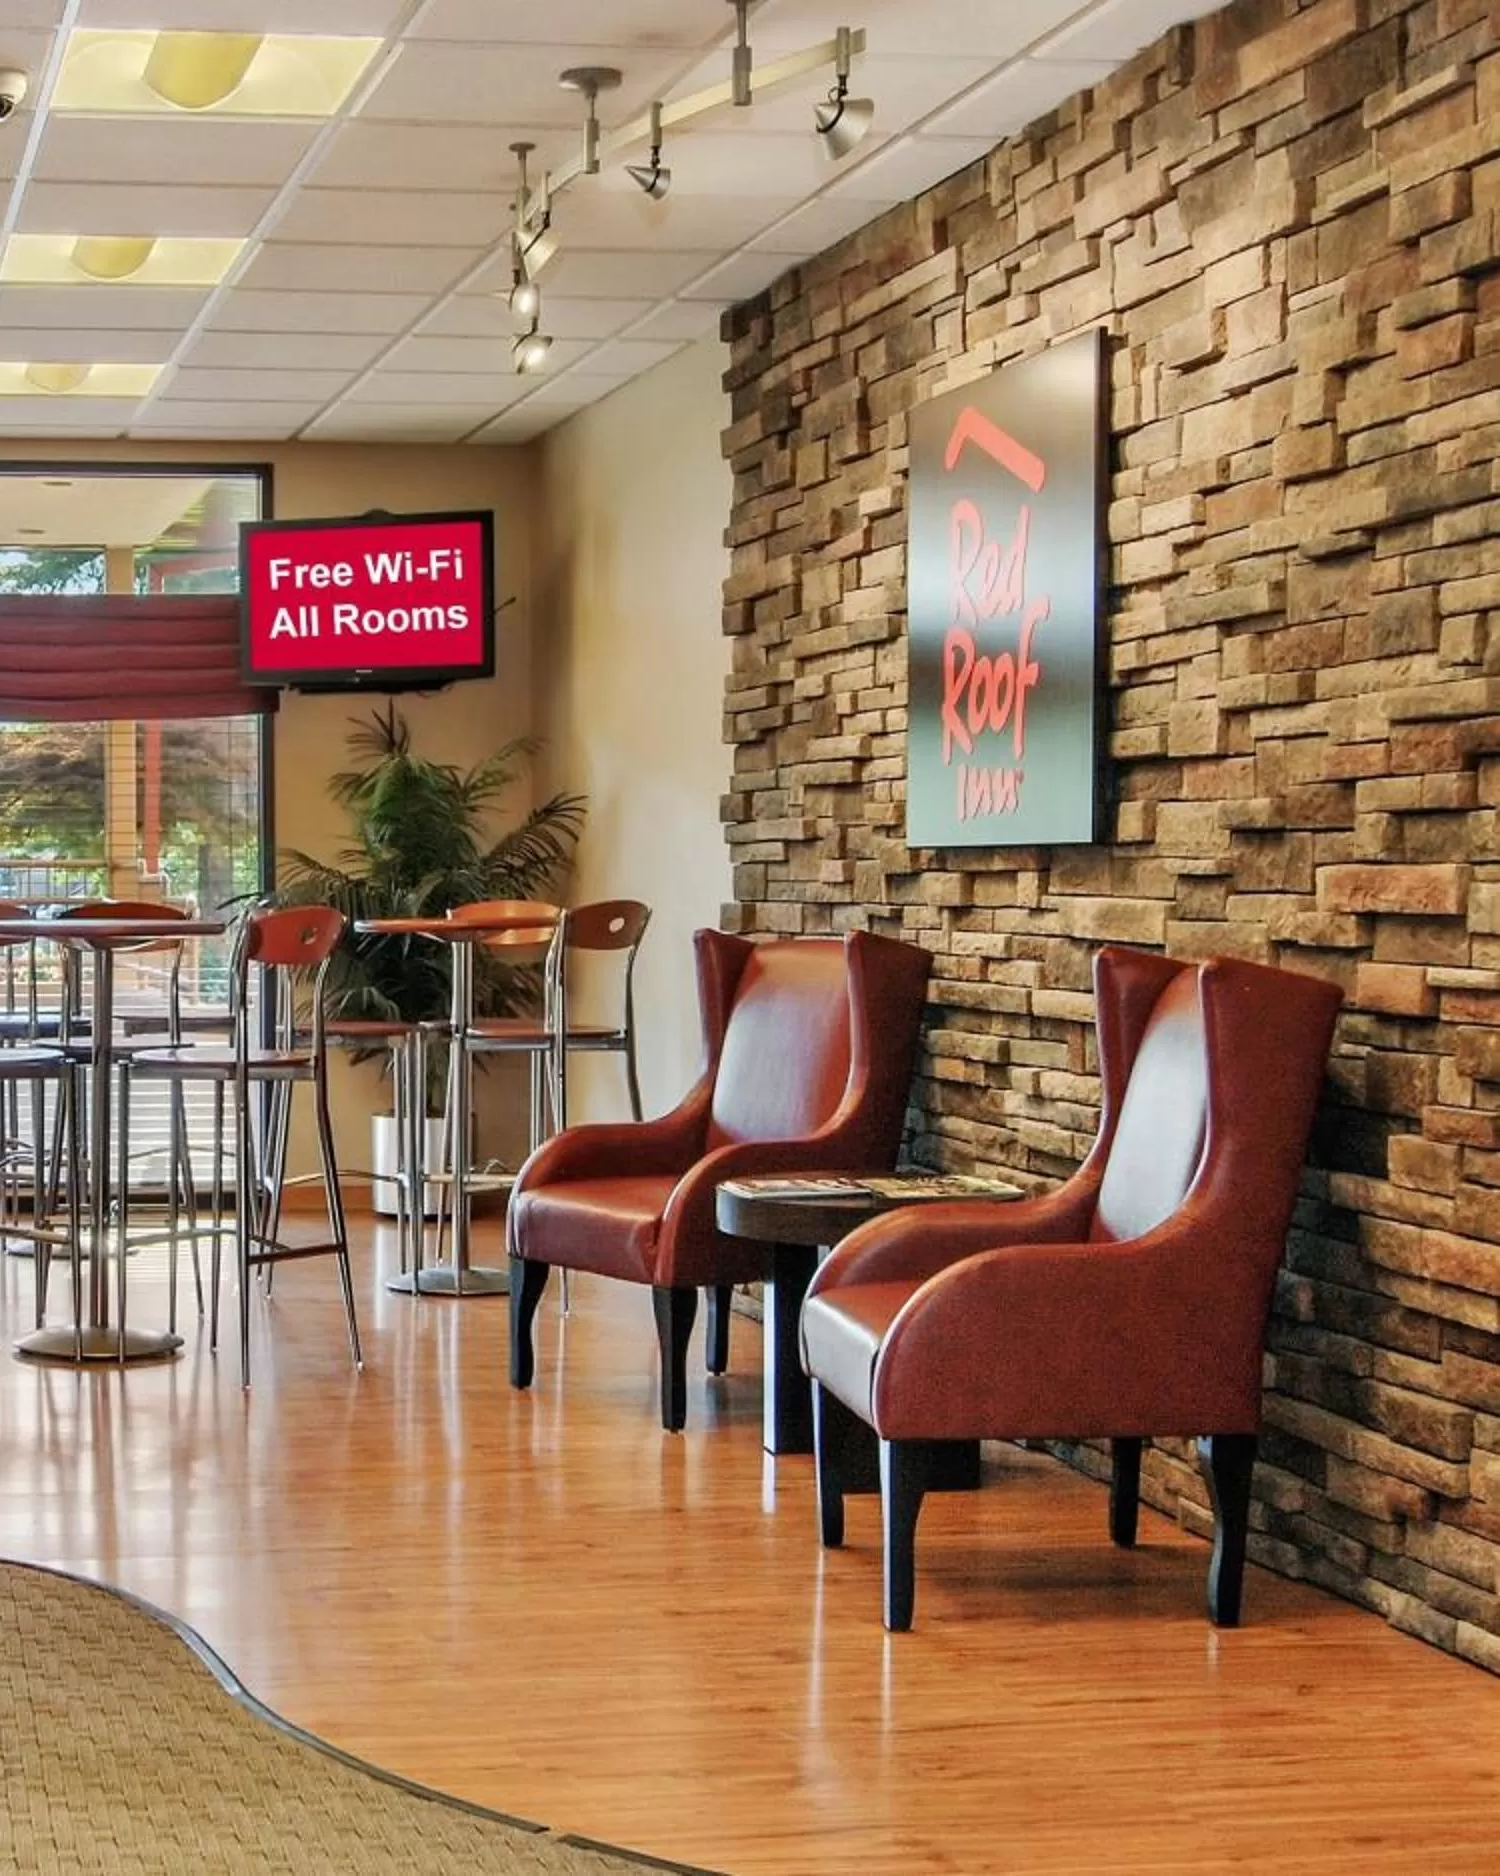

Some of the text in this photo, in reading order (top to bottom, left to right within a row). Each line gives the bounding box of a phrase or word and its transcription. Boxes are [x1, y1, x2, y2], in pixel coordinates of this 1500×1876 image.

[269, 549, 464, 590] Free Wi-Fi
[950, 499, 1031, 628] Red
[269, 603, 469, 639] All Rooms
[942, 593, 1051, 767] Roof
[957, 764, 1024, 823] Inn
